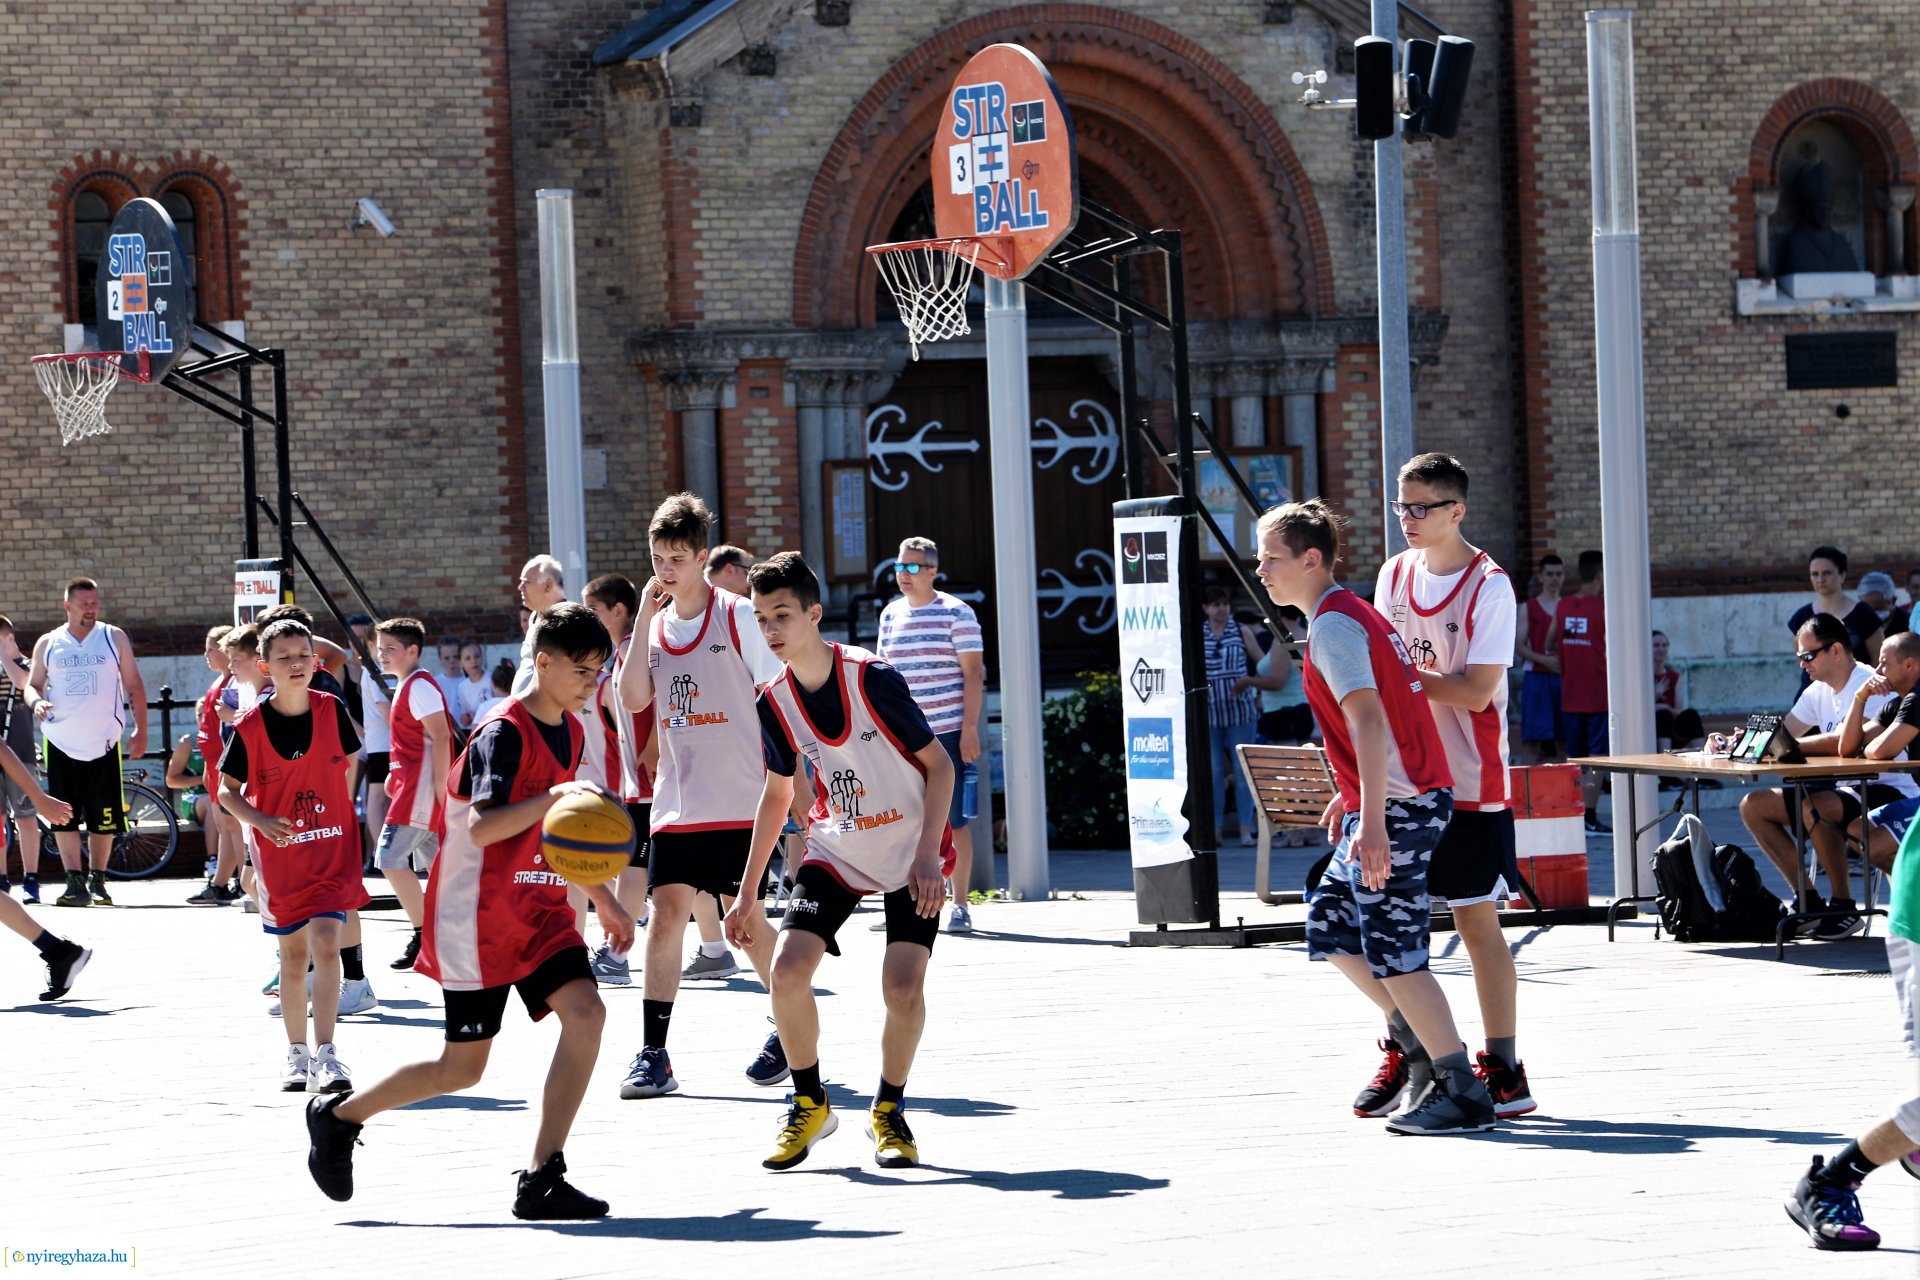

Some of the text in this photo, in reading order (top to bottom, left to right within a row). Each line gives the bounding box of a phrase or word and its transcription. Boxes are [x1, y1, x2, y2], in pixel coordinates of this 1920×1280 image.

[952, 81, 1008, 139] STR
[956, 156, 966, 182] 3
[974, 178, 1049, 236] BALL
[108, 233, 146, 277] STR
[112, 290, 119, 311] 2
[123, 311, 173, 353] BALL
[1123, 606, 1168, 630] MVM
[56, 654, 106, 669] adidas
[66, 671, 97, 696] 21
[1138, 668, 1166, 693] TOTI
[663, 711, 728, 729] REETBALL
[1133, 733, 1169, 752] molten
[102, 807, 113, 825] 5
[555, 854, 609, 872] molten
[513, 870, 568, 887] STREETB
